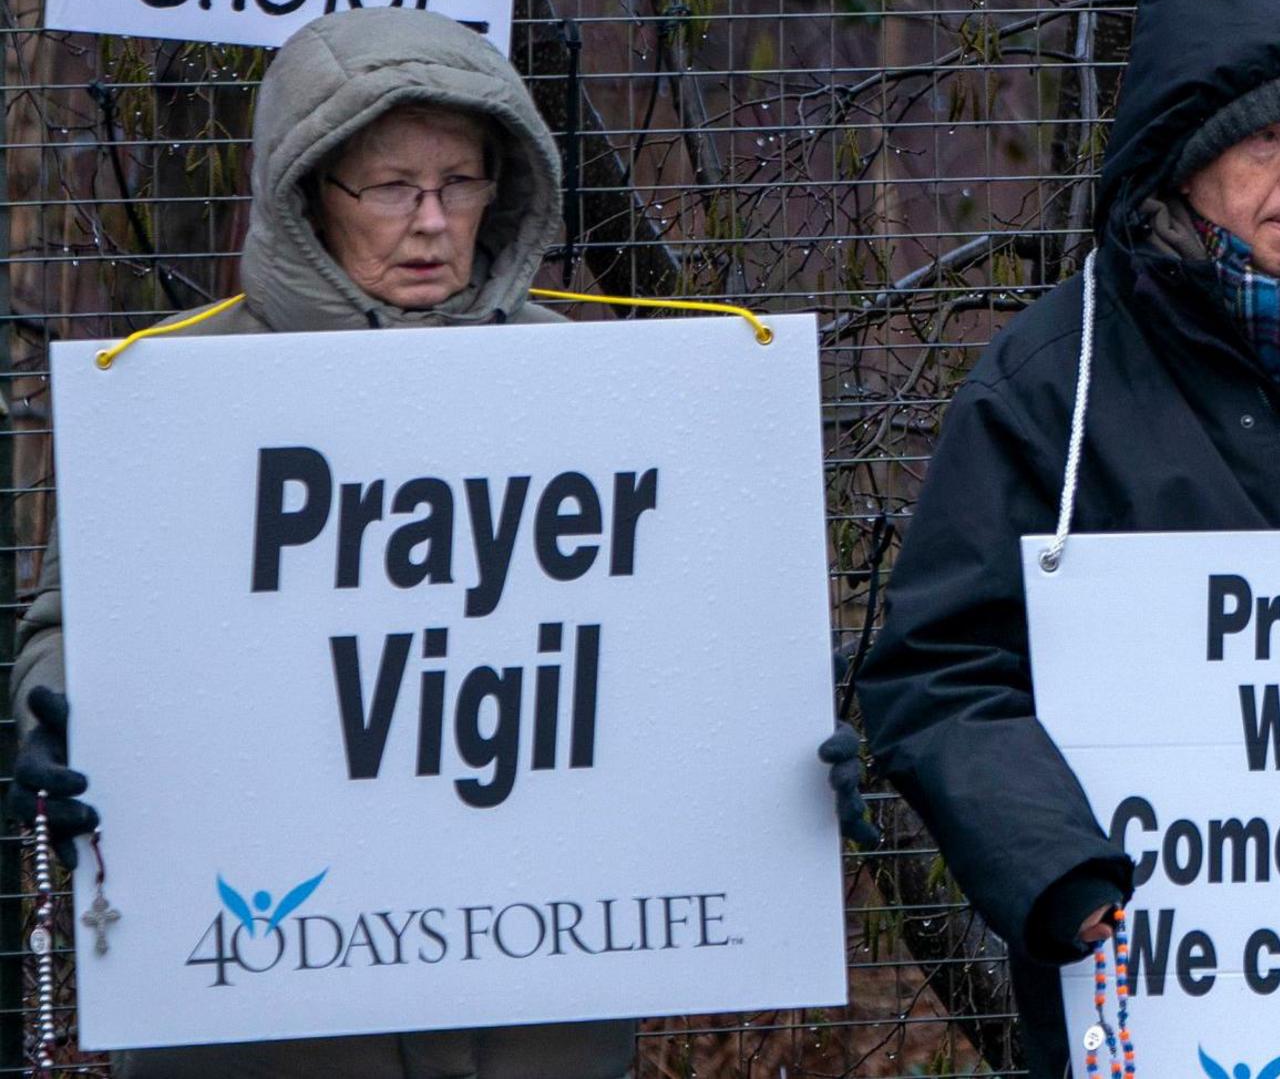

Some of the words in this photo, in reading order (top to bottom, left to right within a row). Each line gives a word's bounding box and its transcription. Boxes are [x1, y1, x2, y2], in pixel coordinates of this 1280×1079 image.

[250, 445, 659, 618] Prayer
[329, 622, 603, 809] Vigil
[184, 907, 285, 988] 40
[293, 907, 447, 970] DAYS
[458, 901, 598, 961] FOR
[596, 892, 731, 954] LIFE
[1113, 908, 1217, 997] We
